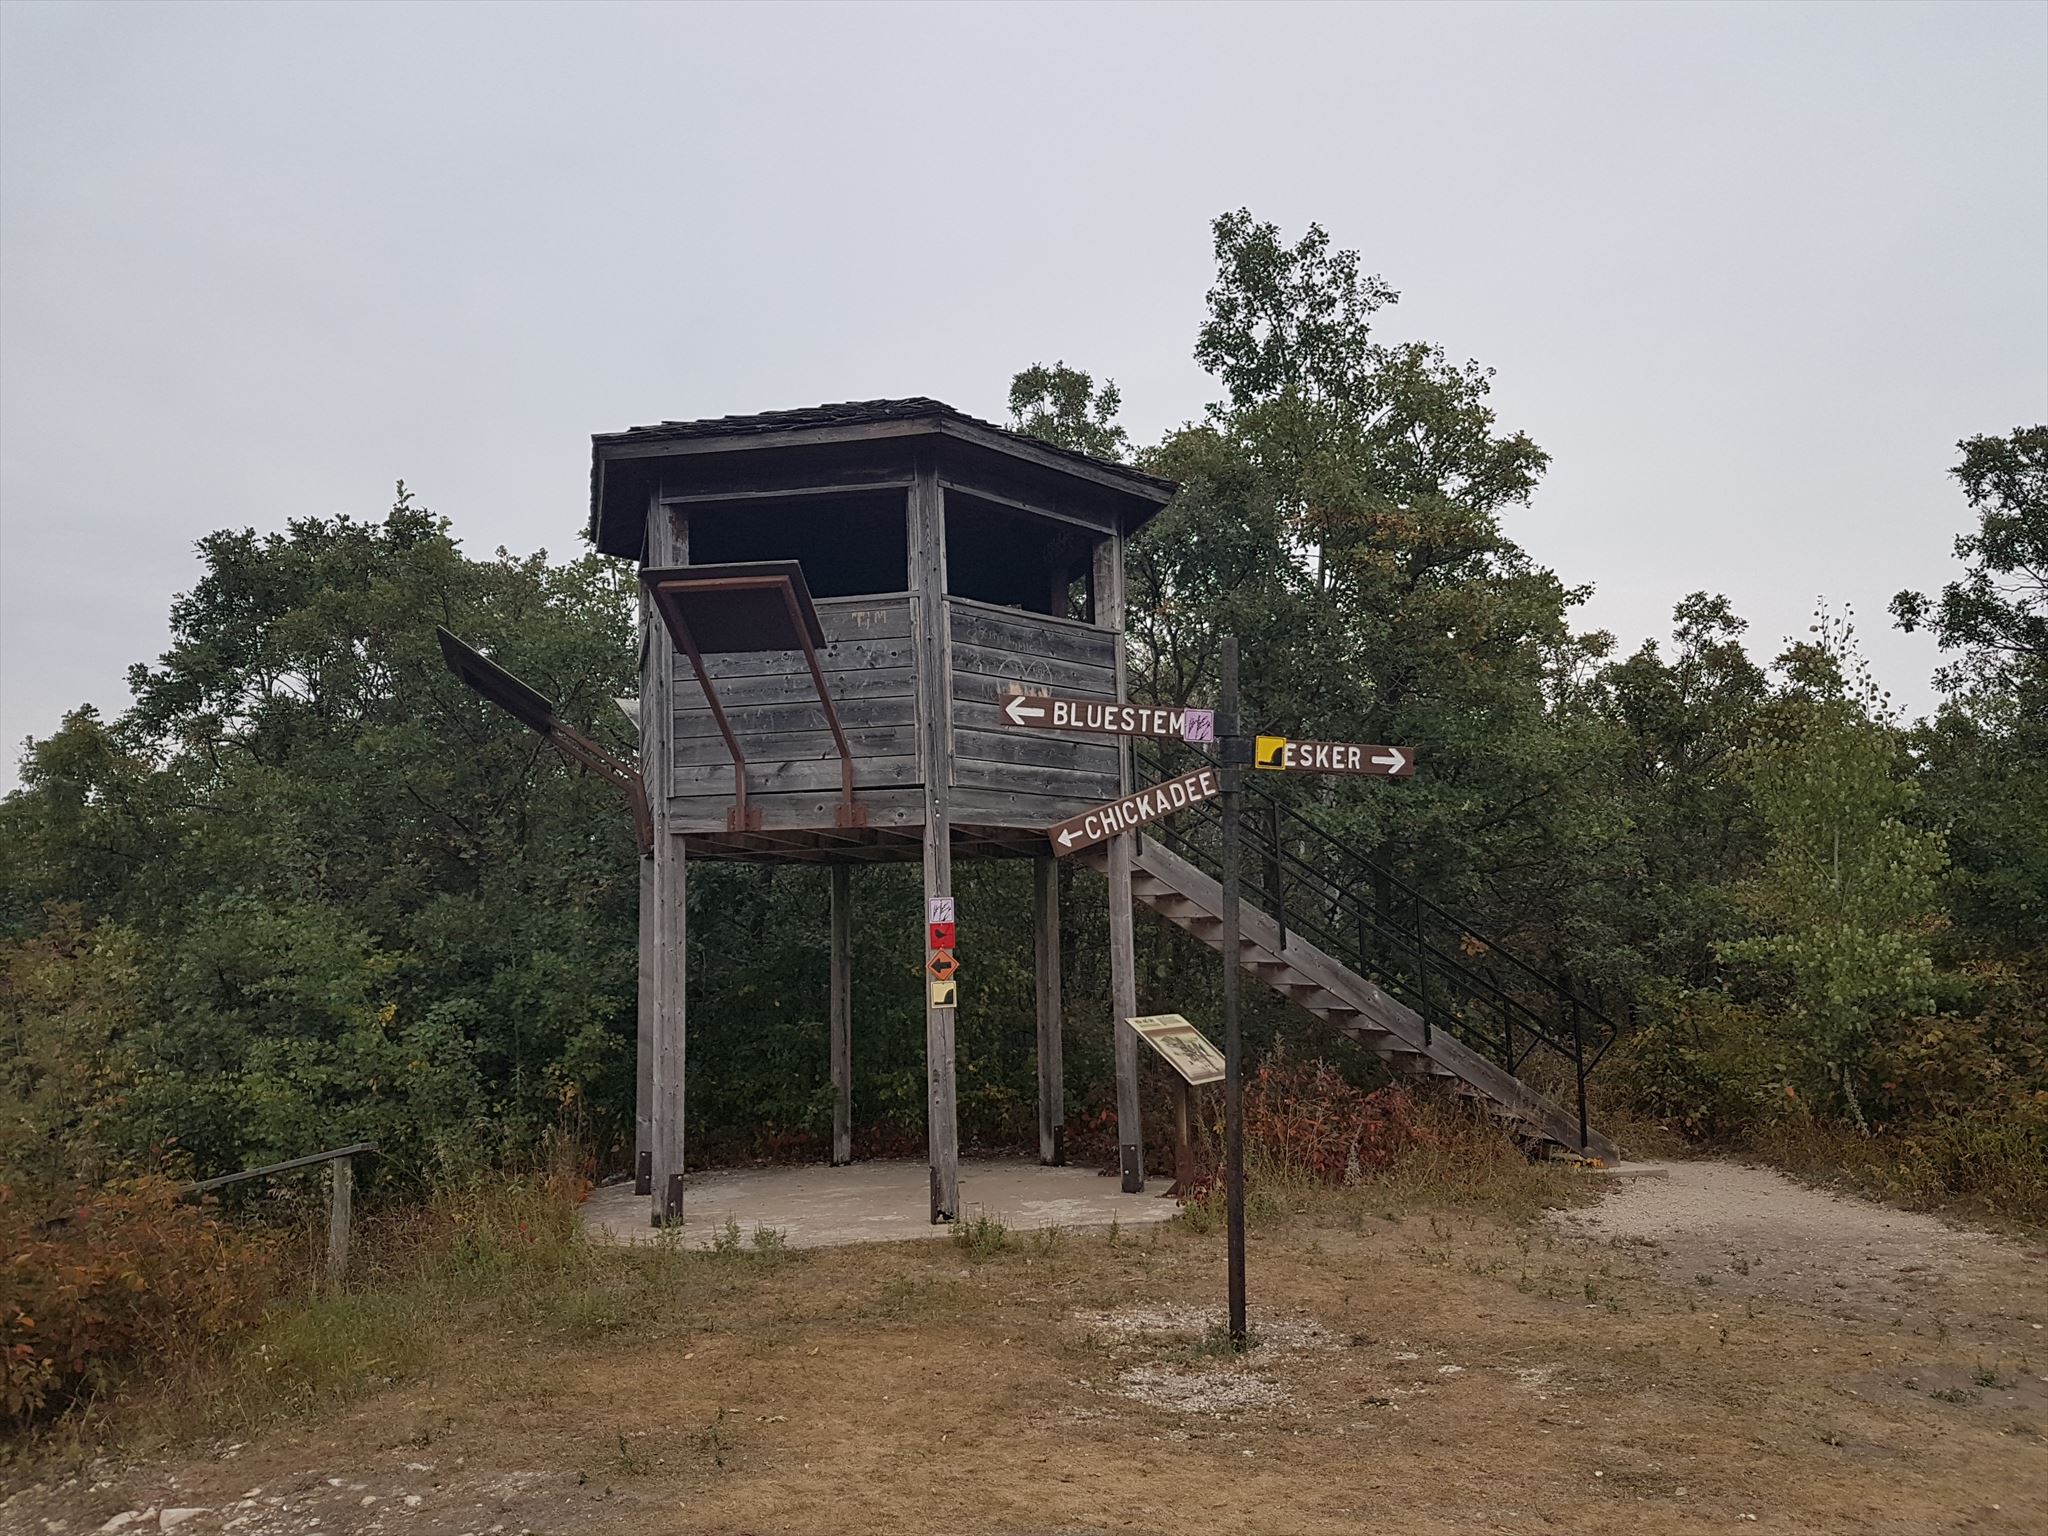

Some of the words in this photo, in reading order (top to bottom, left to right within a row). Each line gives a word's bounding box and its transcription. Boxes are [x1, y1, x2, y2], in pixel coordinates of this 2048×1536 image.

[1053, 701, 1184, 736] BLUESTEM
[1286, 743, 1361, 770] ESKER
[1084, 772, 1216, 840] CHICKADEE
